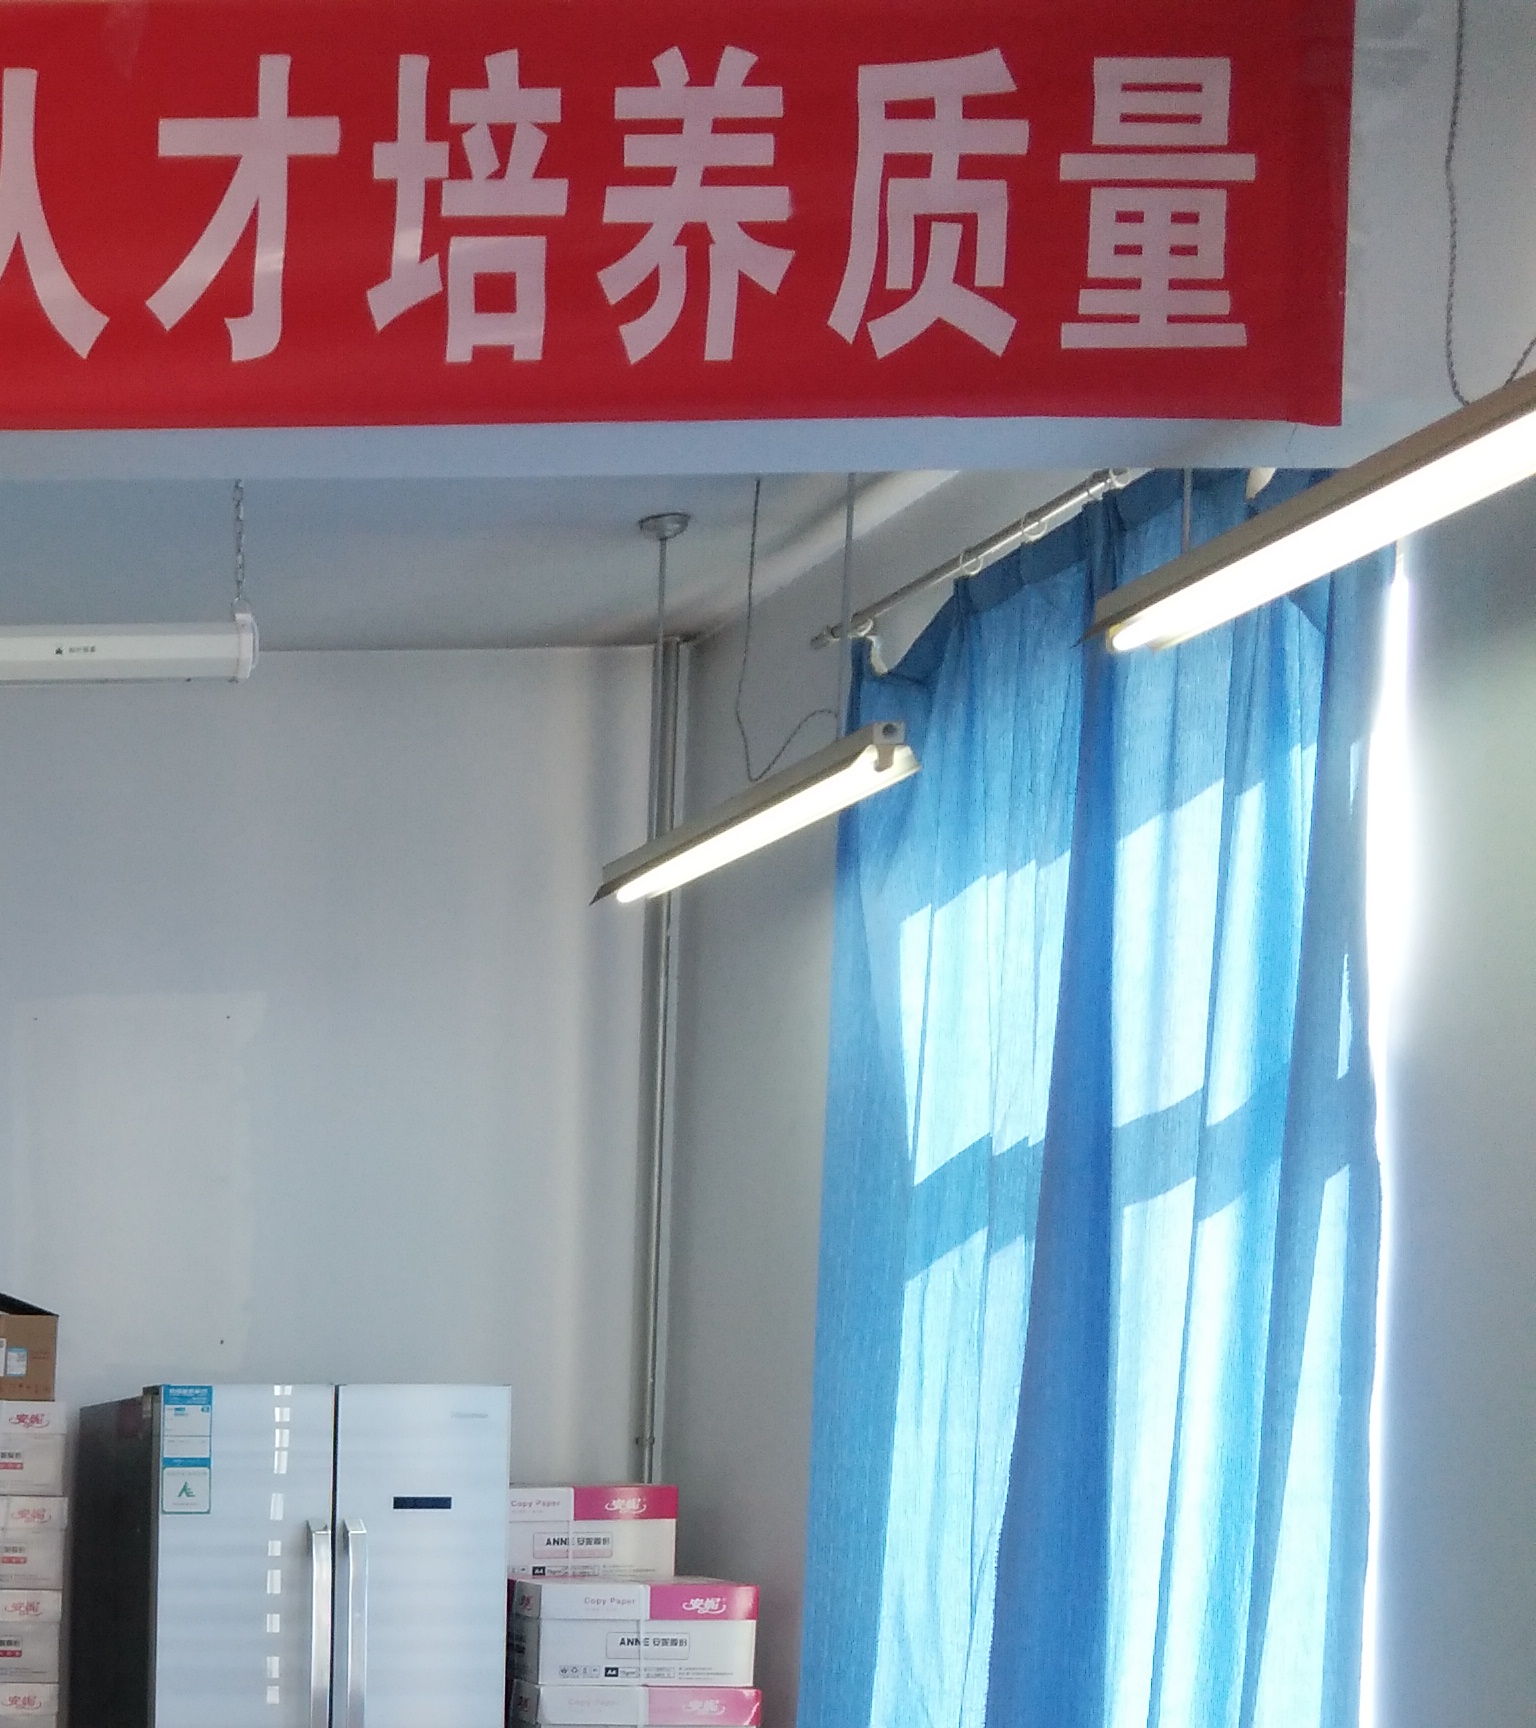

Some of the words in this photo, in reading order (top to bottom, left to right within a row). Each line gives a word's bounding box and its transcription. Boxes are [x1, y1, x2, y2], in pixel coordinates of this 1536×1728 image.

[511, 1499, 533, 1508] Copy
[535, 1499, 561, 1508] Paper
[584, 1597, 607, 1606] Copy
[610, 1597, 636, 1606] Paper
